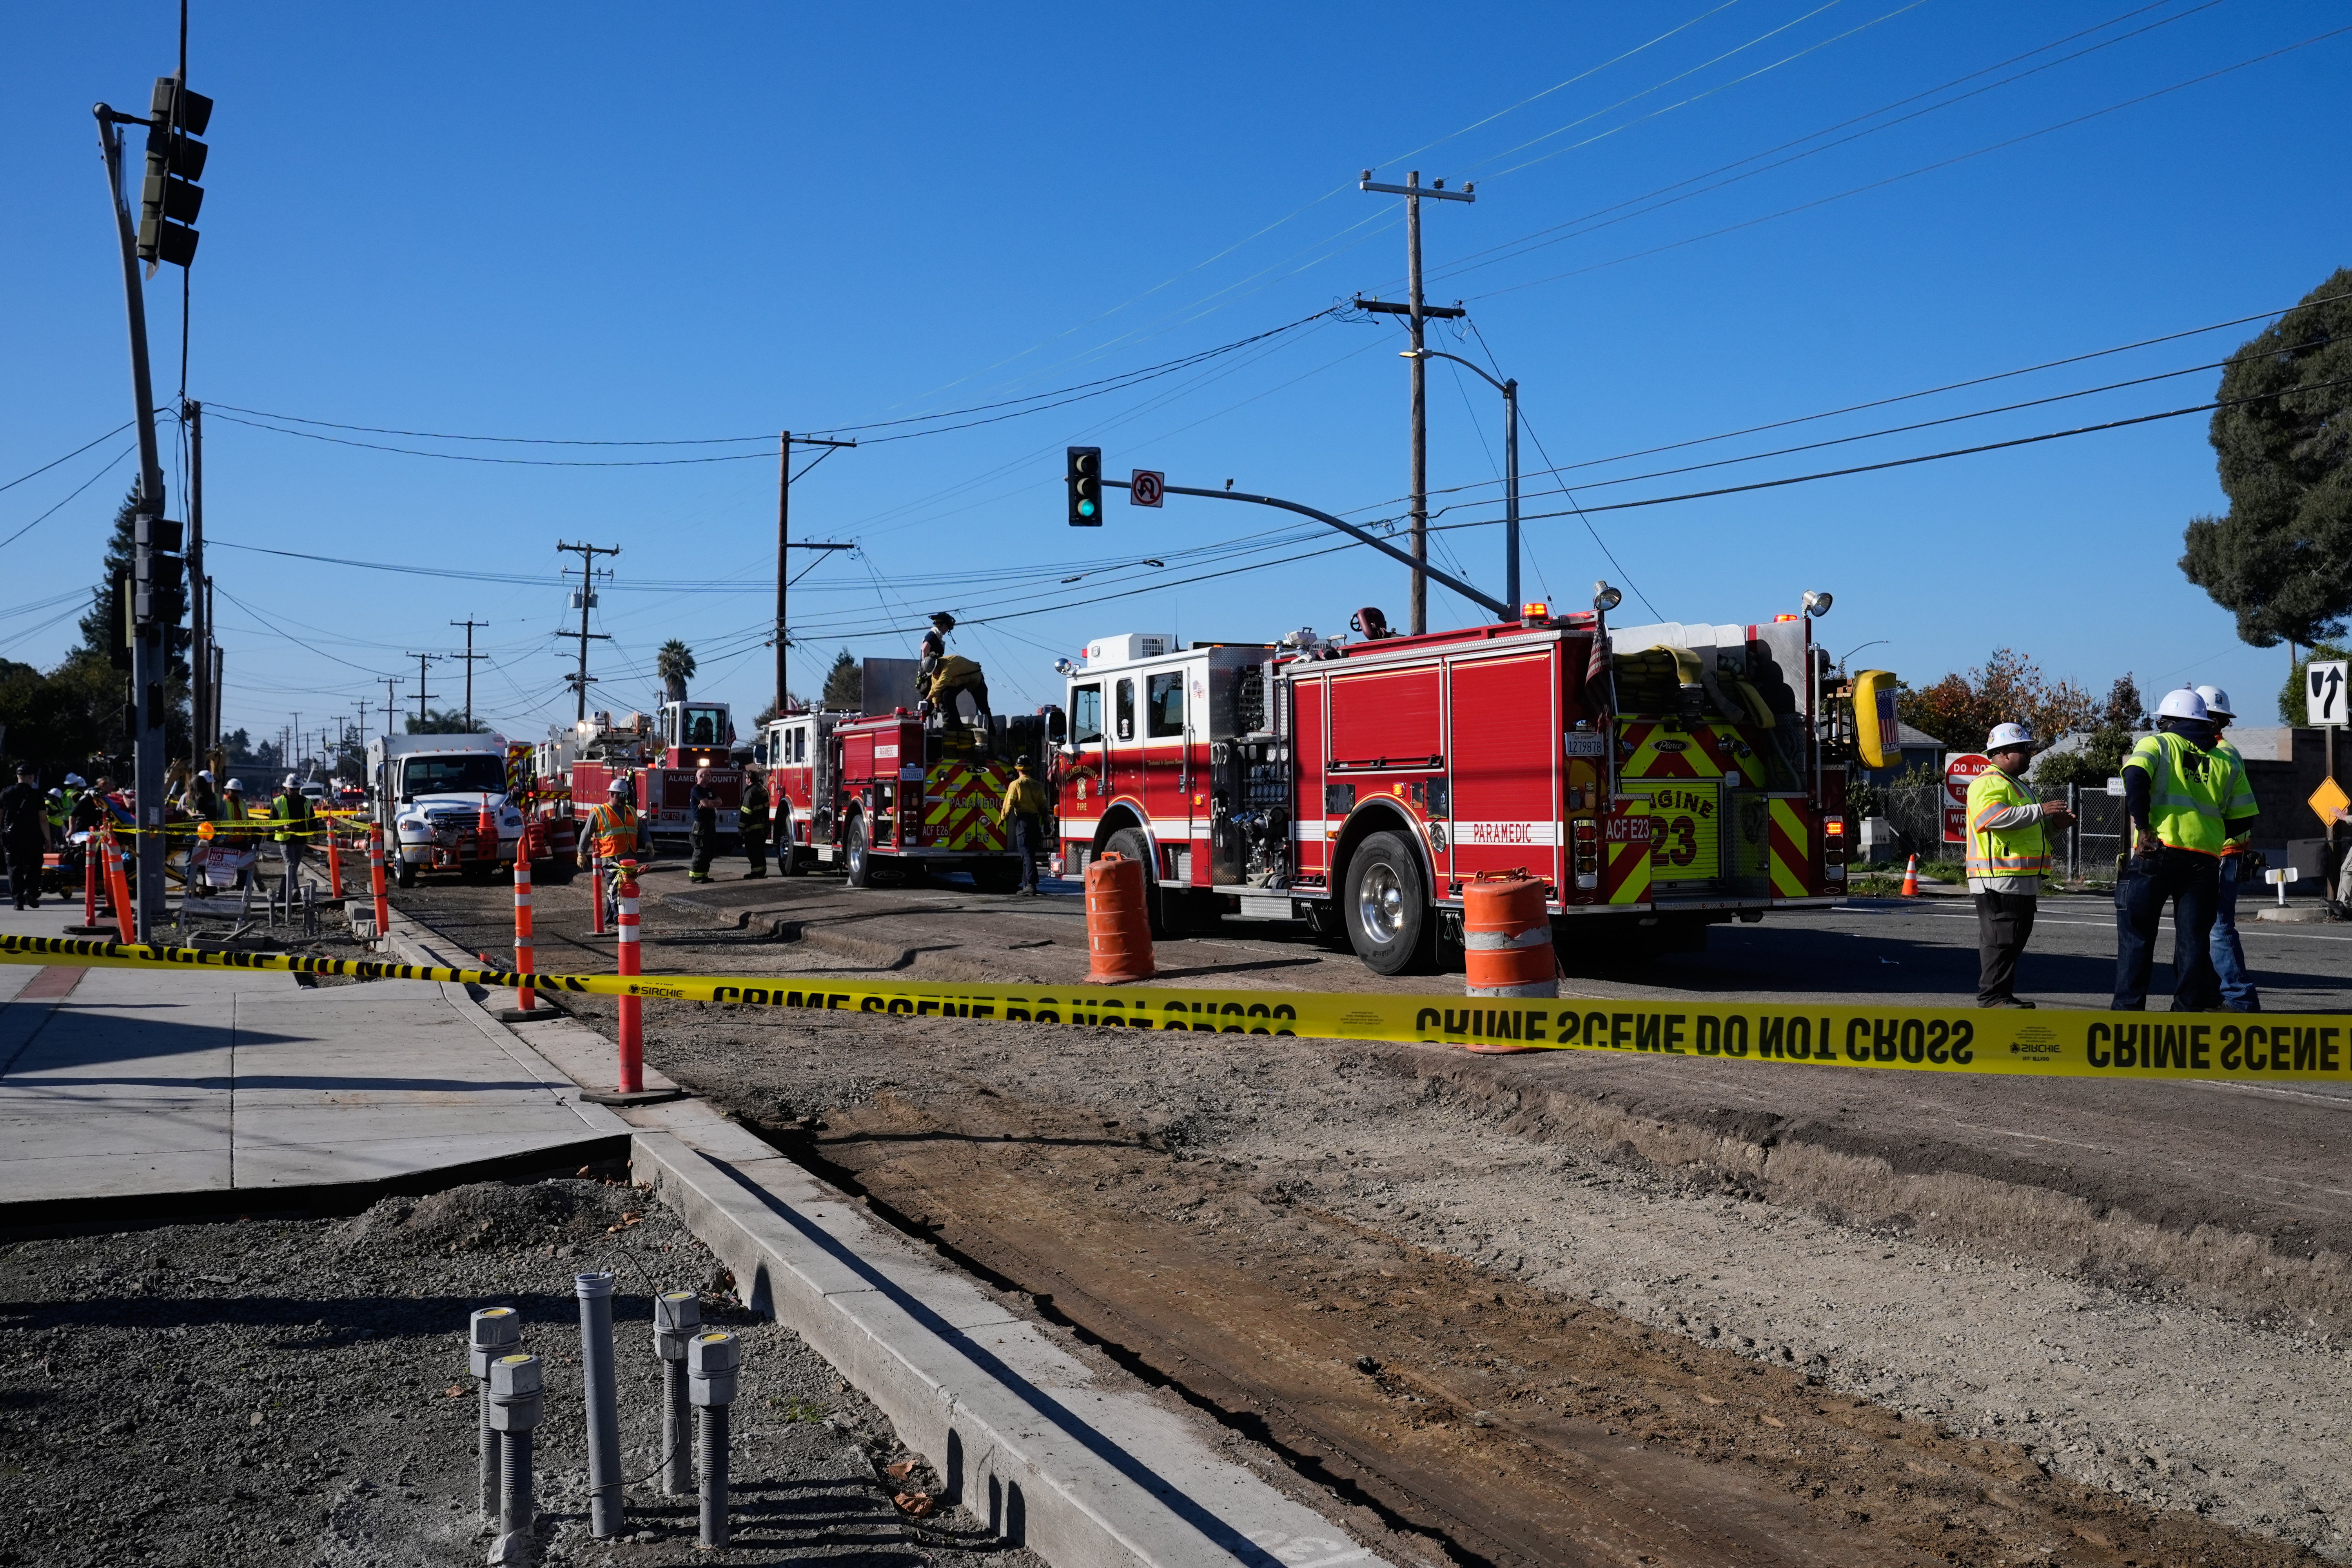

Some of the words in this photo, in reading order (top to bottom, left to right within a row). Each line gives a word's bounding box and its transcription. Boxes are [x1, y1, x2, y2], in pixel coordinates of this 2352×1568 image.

[1877, 690, 1896, 699] KEE
[1568, 741, 1601, 753] 1279878
[1659, 741, 1682, 751] Pierce
[1882, 743, 1900, 751] BAC
[1065, 765, 1082, 782] ALAMEDA
[1082, 765, 1098, 780] COUNTY
[1953, 763, 1967, 772] DO
[1076, 802, 1087, 811] FIRE
[1651, 790, 1714, 819] GINE
[922, 825, 934, 836] ACF
[936, 825, 949, 836] E26
[1474, 823, 1532, 843] PARAMEDIC
[1605, 819, 1628, 839] ACF
[1631, 818, 1650, 839] E23
[1651, 815, 1697, 867] 23
[641, 986, 683, 998] SIRCHIE
